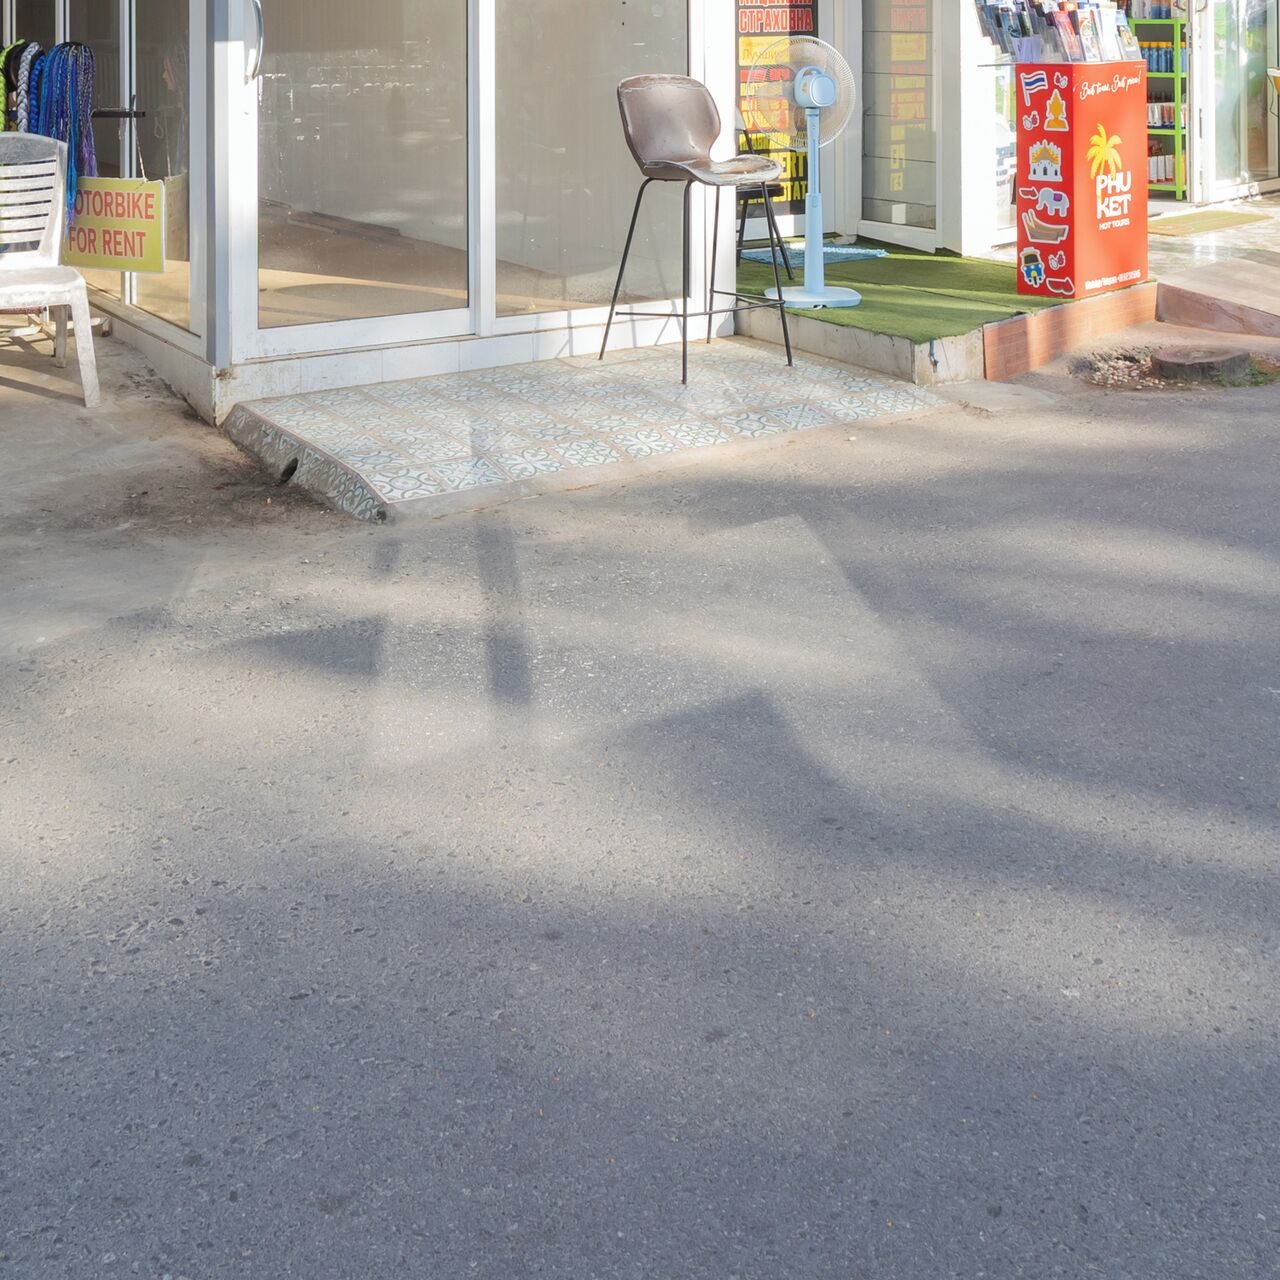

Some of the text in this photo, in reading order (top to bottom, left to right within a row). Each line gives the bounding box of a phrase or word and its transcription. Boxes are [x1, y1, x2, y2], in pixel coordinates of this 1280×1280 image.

[1095, 170, 1132, 196] PHU
[73, 190, 156, 220] OTORBIKE
[1096, 193, 1132, 220] KET
[69, 227, 147, 259] FOR RENT
